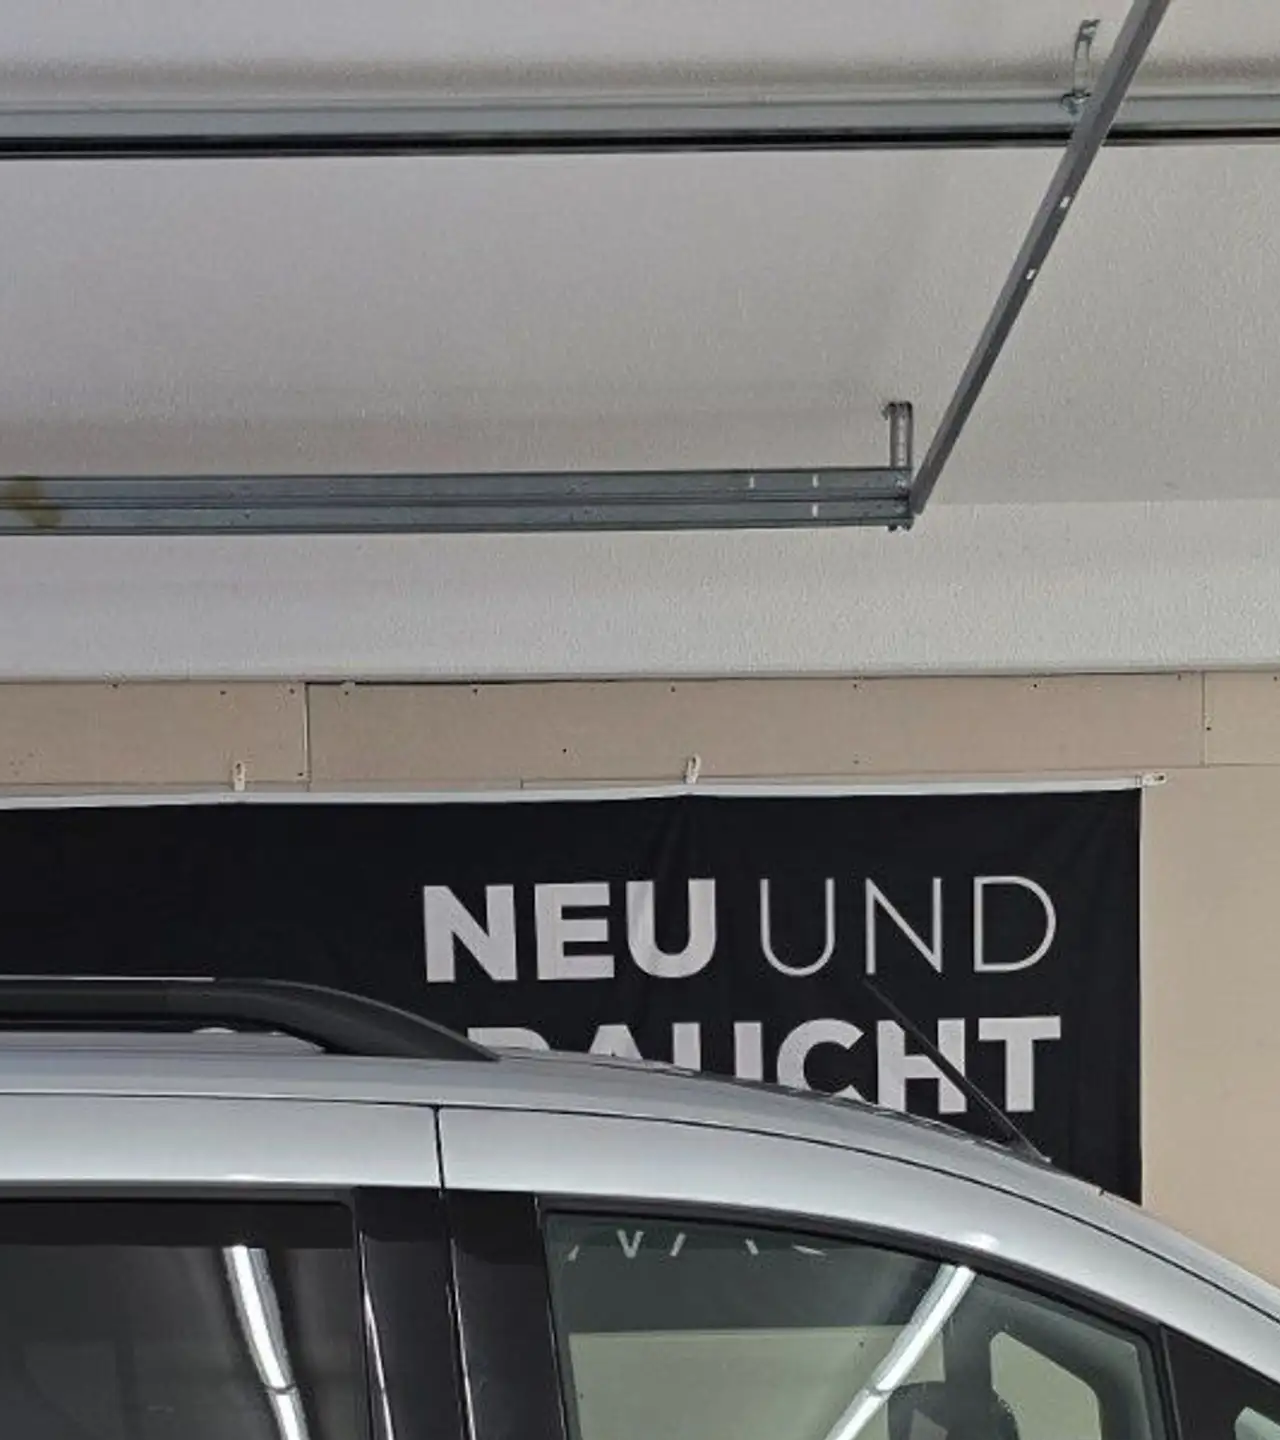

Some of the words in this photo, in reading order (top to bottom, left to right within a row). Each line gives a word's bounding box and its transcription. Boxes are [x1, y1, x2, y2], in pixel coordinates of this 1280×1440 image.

[422, 877, 718, 984] NEU
[759, 875, 1058, 978] UND
[467, 1015, 1062, 1114] UCHT
